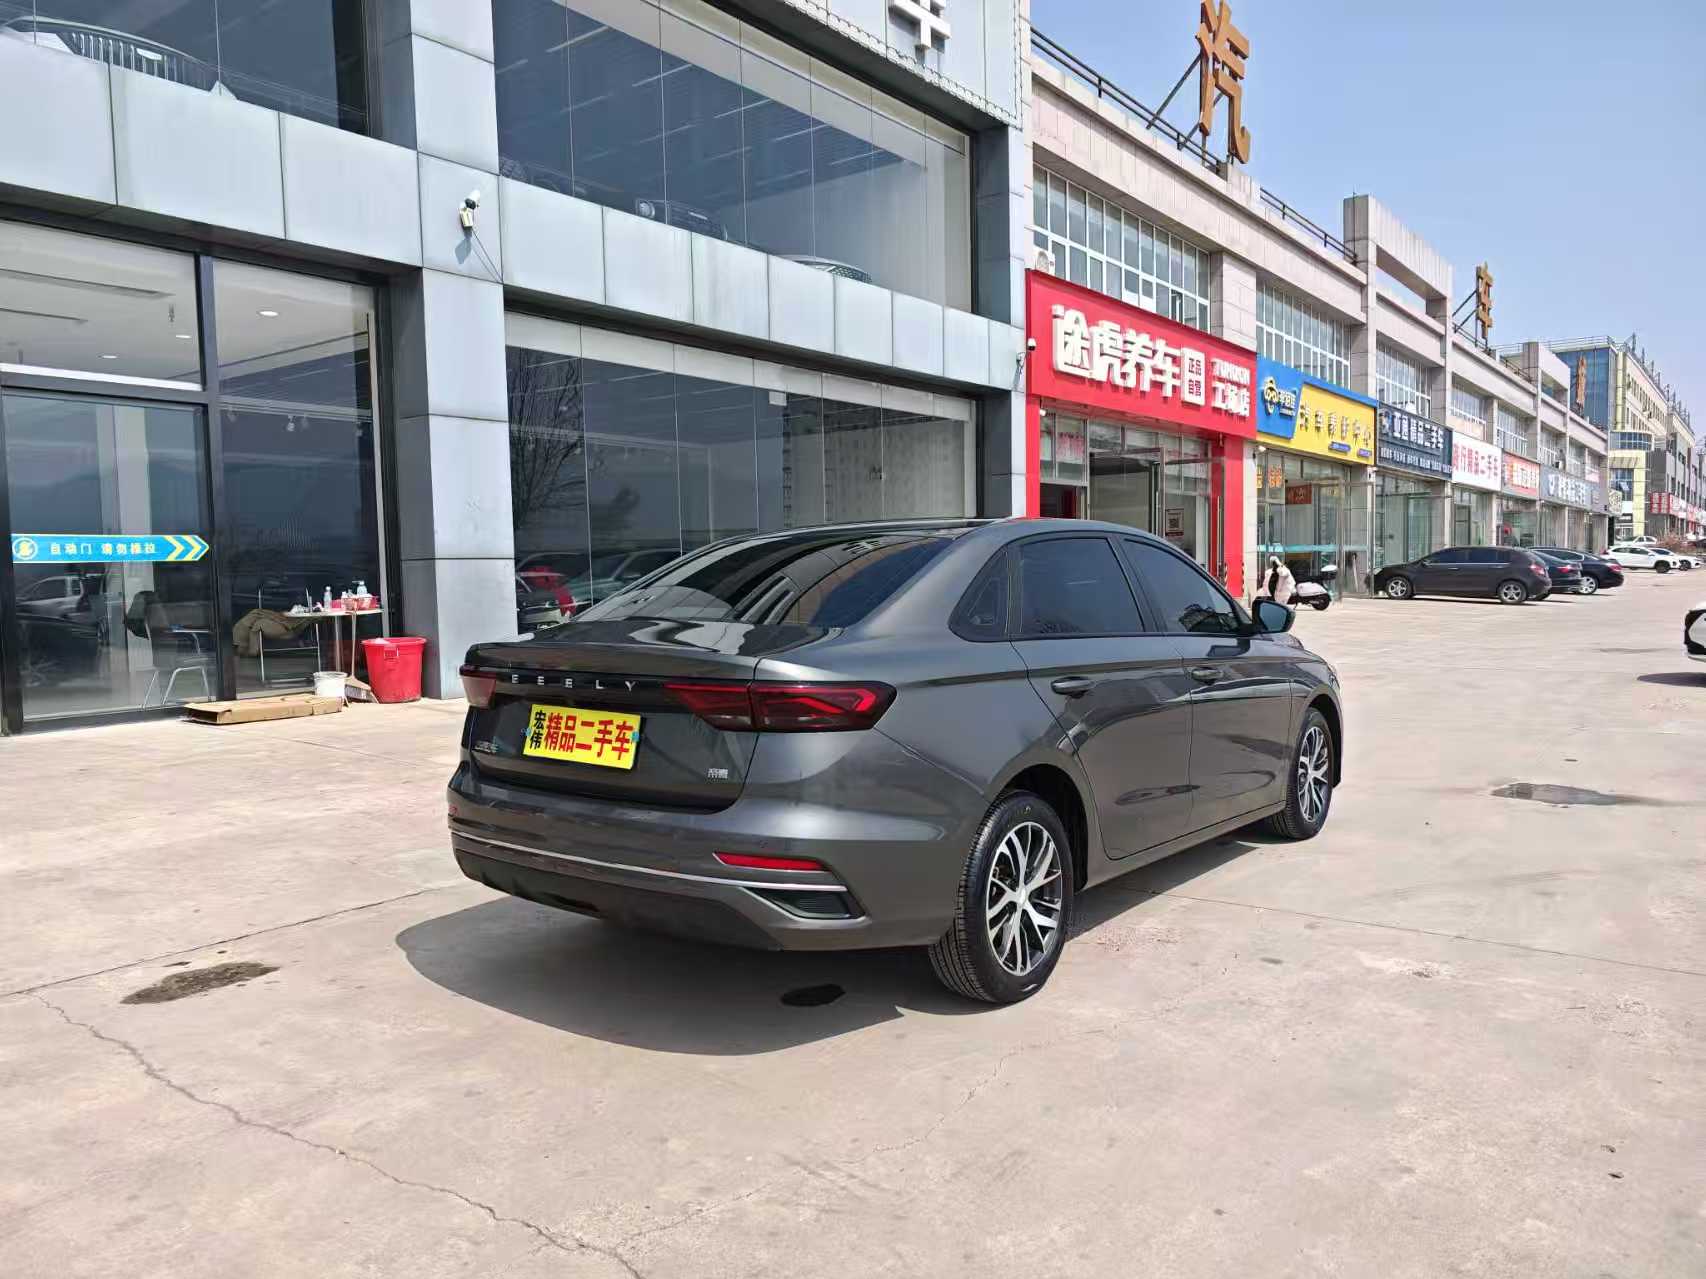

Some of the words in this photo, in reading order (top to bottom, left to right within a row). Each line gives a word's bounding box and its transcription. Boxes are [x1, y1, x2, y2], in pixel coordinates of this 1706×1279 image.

[1195, 0, 1251, 164] 汽
[1052, 304, 1181, 397] 途虎养车
[50, 542, 92, 555] 自动门
[529, 709, 547, 750] 宏伟
[544, 712, 635, 761] 精品二手车
